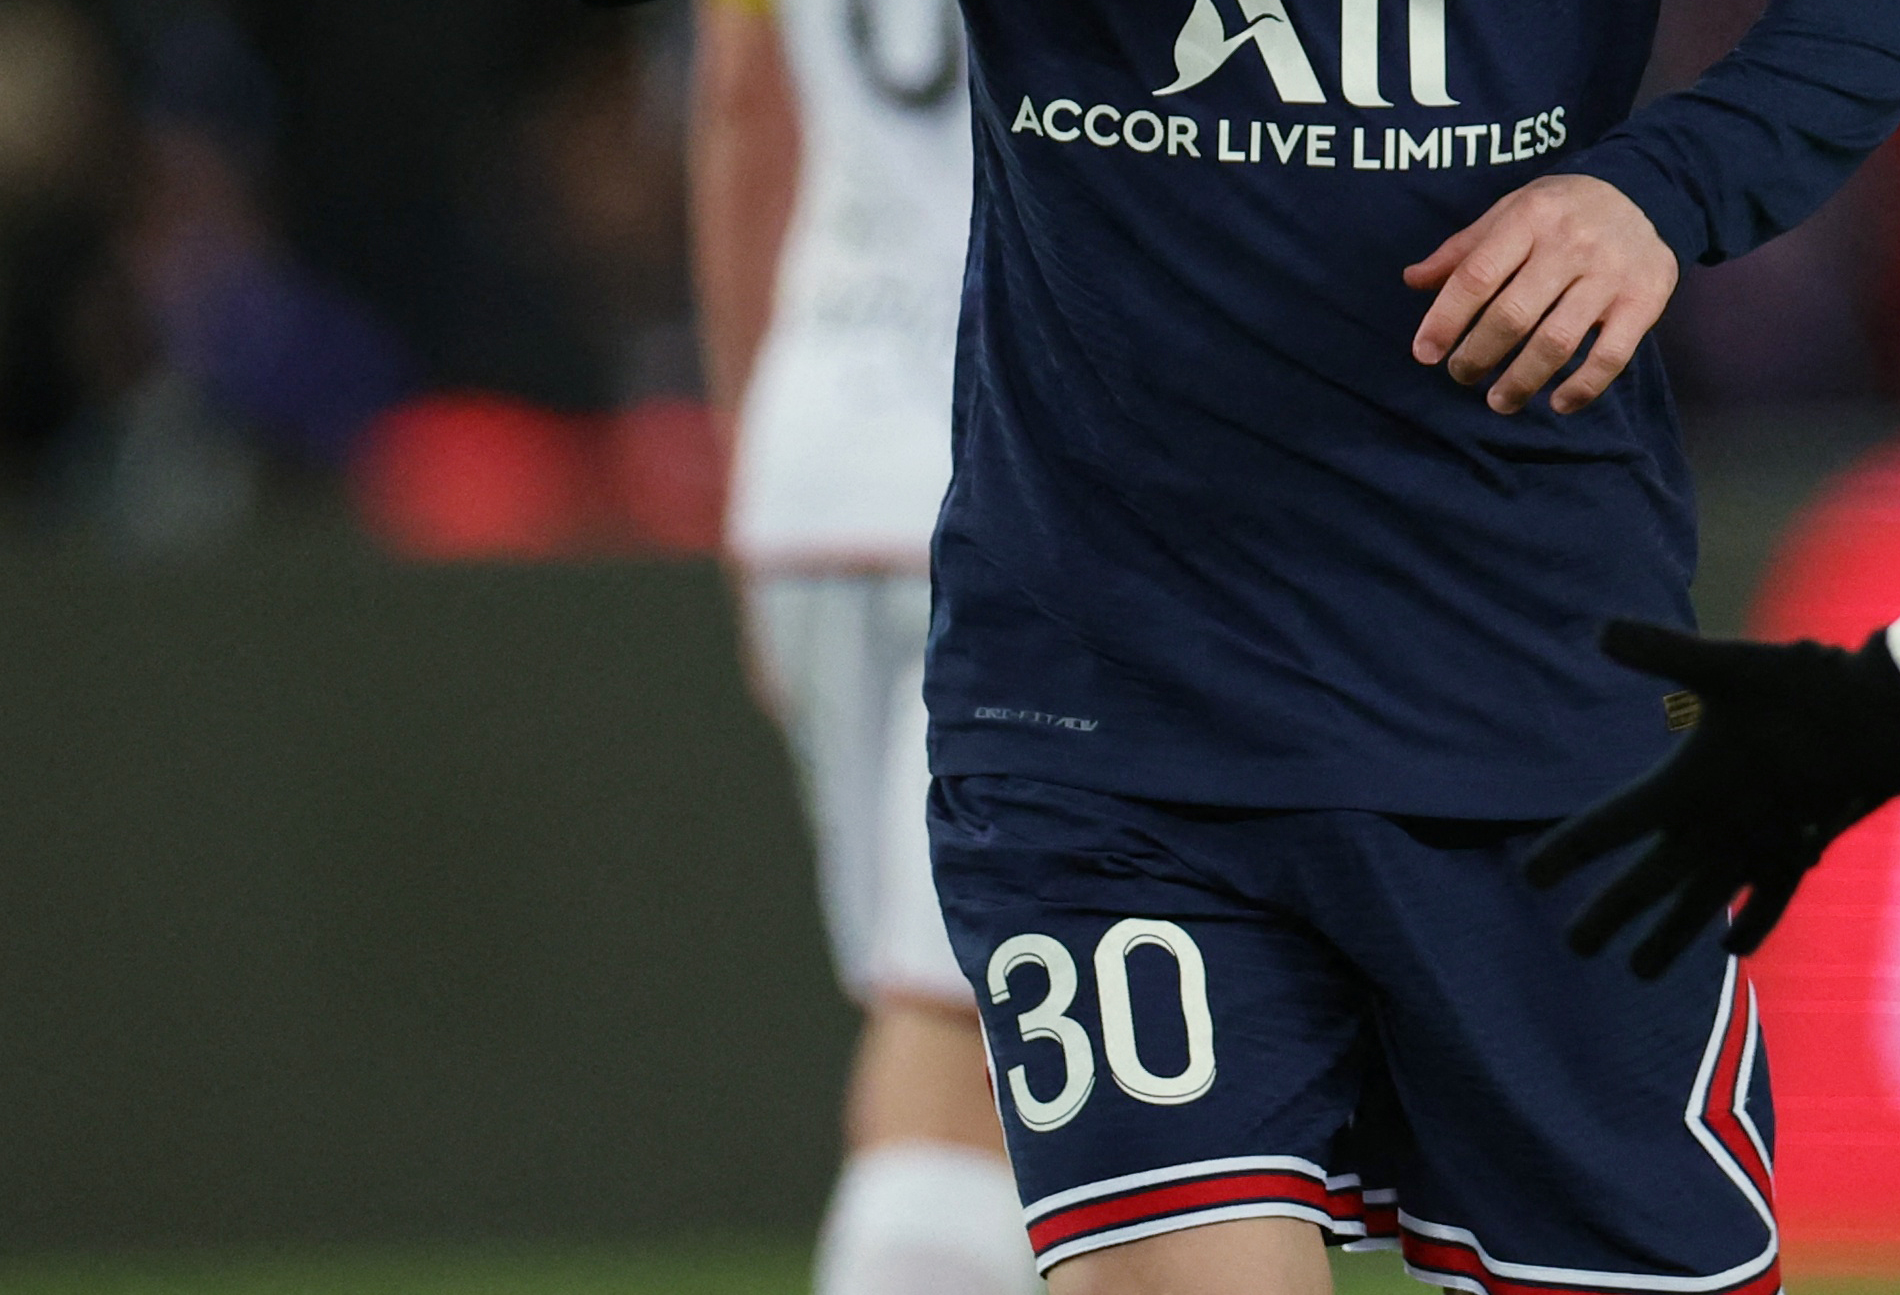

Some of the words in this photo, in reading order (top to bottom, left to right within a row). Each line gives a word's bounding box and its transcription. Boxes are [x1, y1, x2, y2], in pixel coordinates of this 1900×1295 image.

[1010, 94, 1201, 158] ACCOR
[1217, 119, 1337, 168] LIVE
[1352, 106, 1567, 171] LIMITLESS
[986, 917, 1217, 1133] 30
